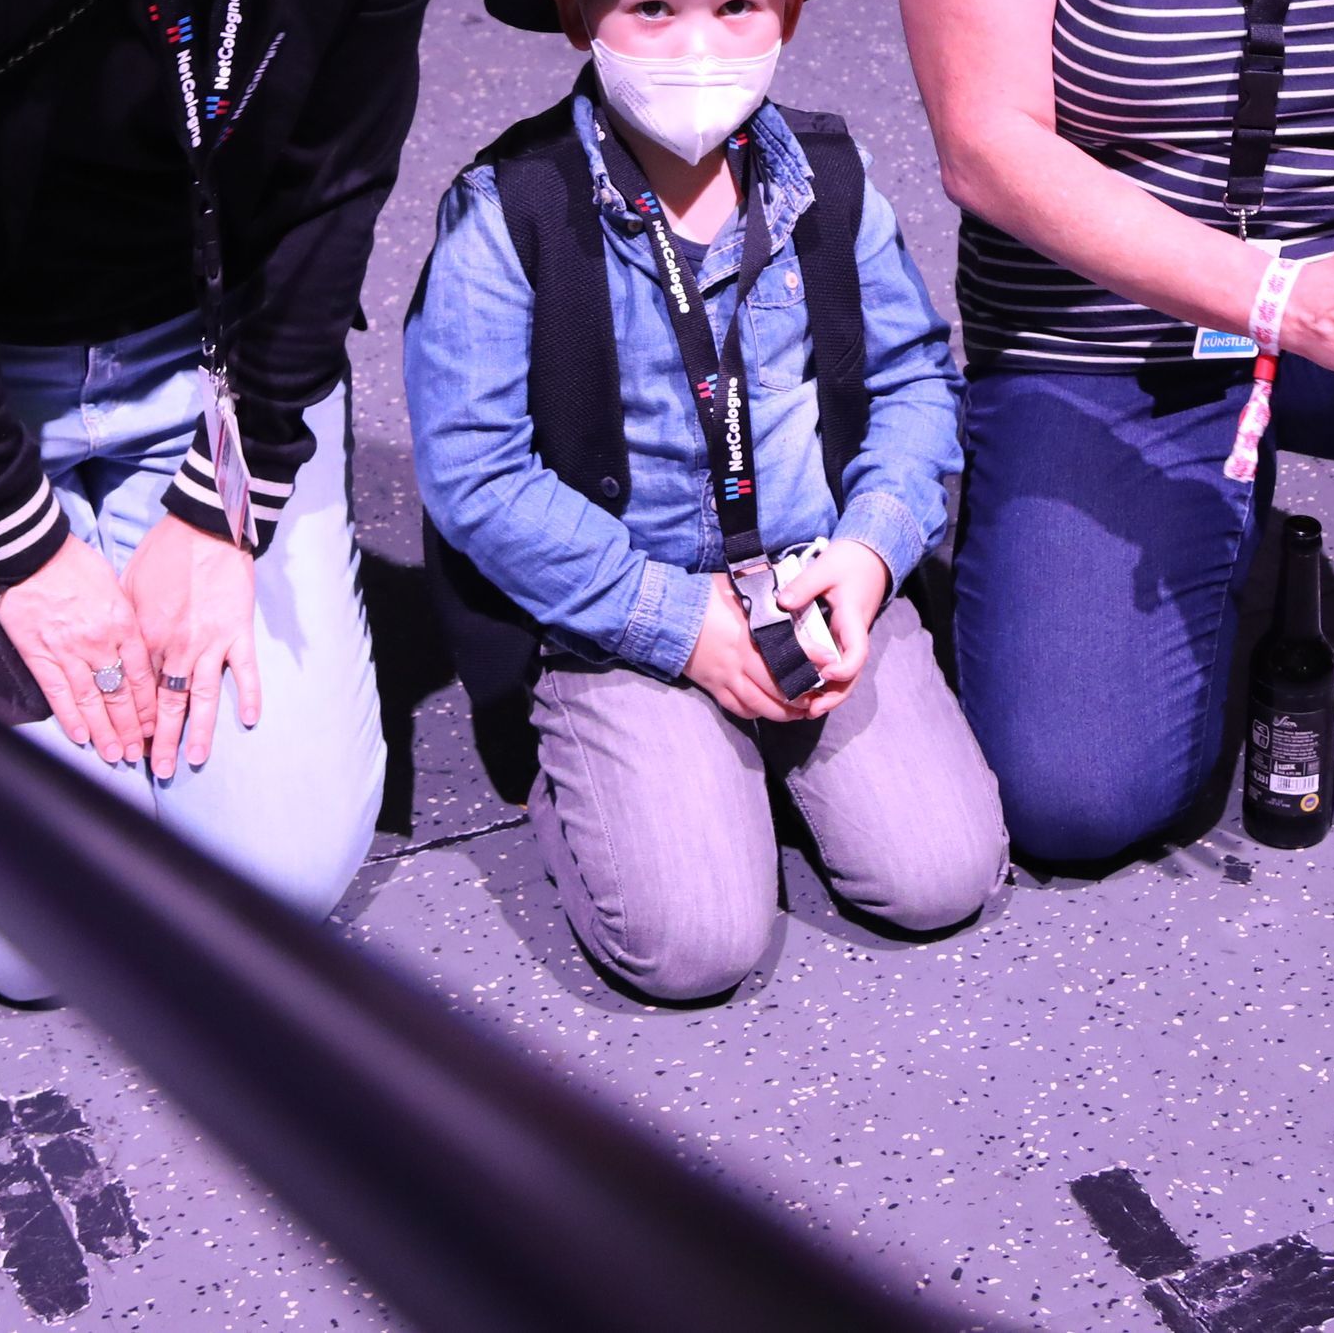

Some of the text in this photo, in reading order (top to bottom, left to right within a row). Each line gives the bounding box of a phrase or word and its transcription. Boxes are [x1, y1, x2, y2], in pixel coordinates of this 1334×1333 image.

[177, 49, 202, 148] NetCologne
[652, 220, 691, 314] NetCologne
[1202, 335, 1255, 347] KÜNSTLER
[724, 377, 744, 472] NetCologne
